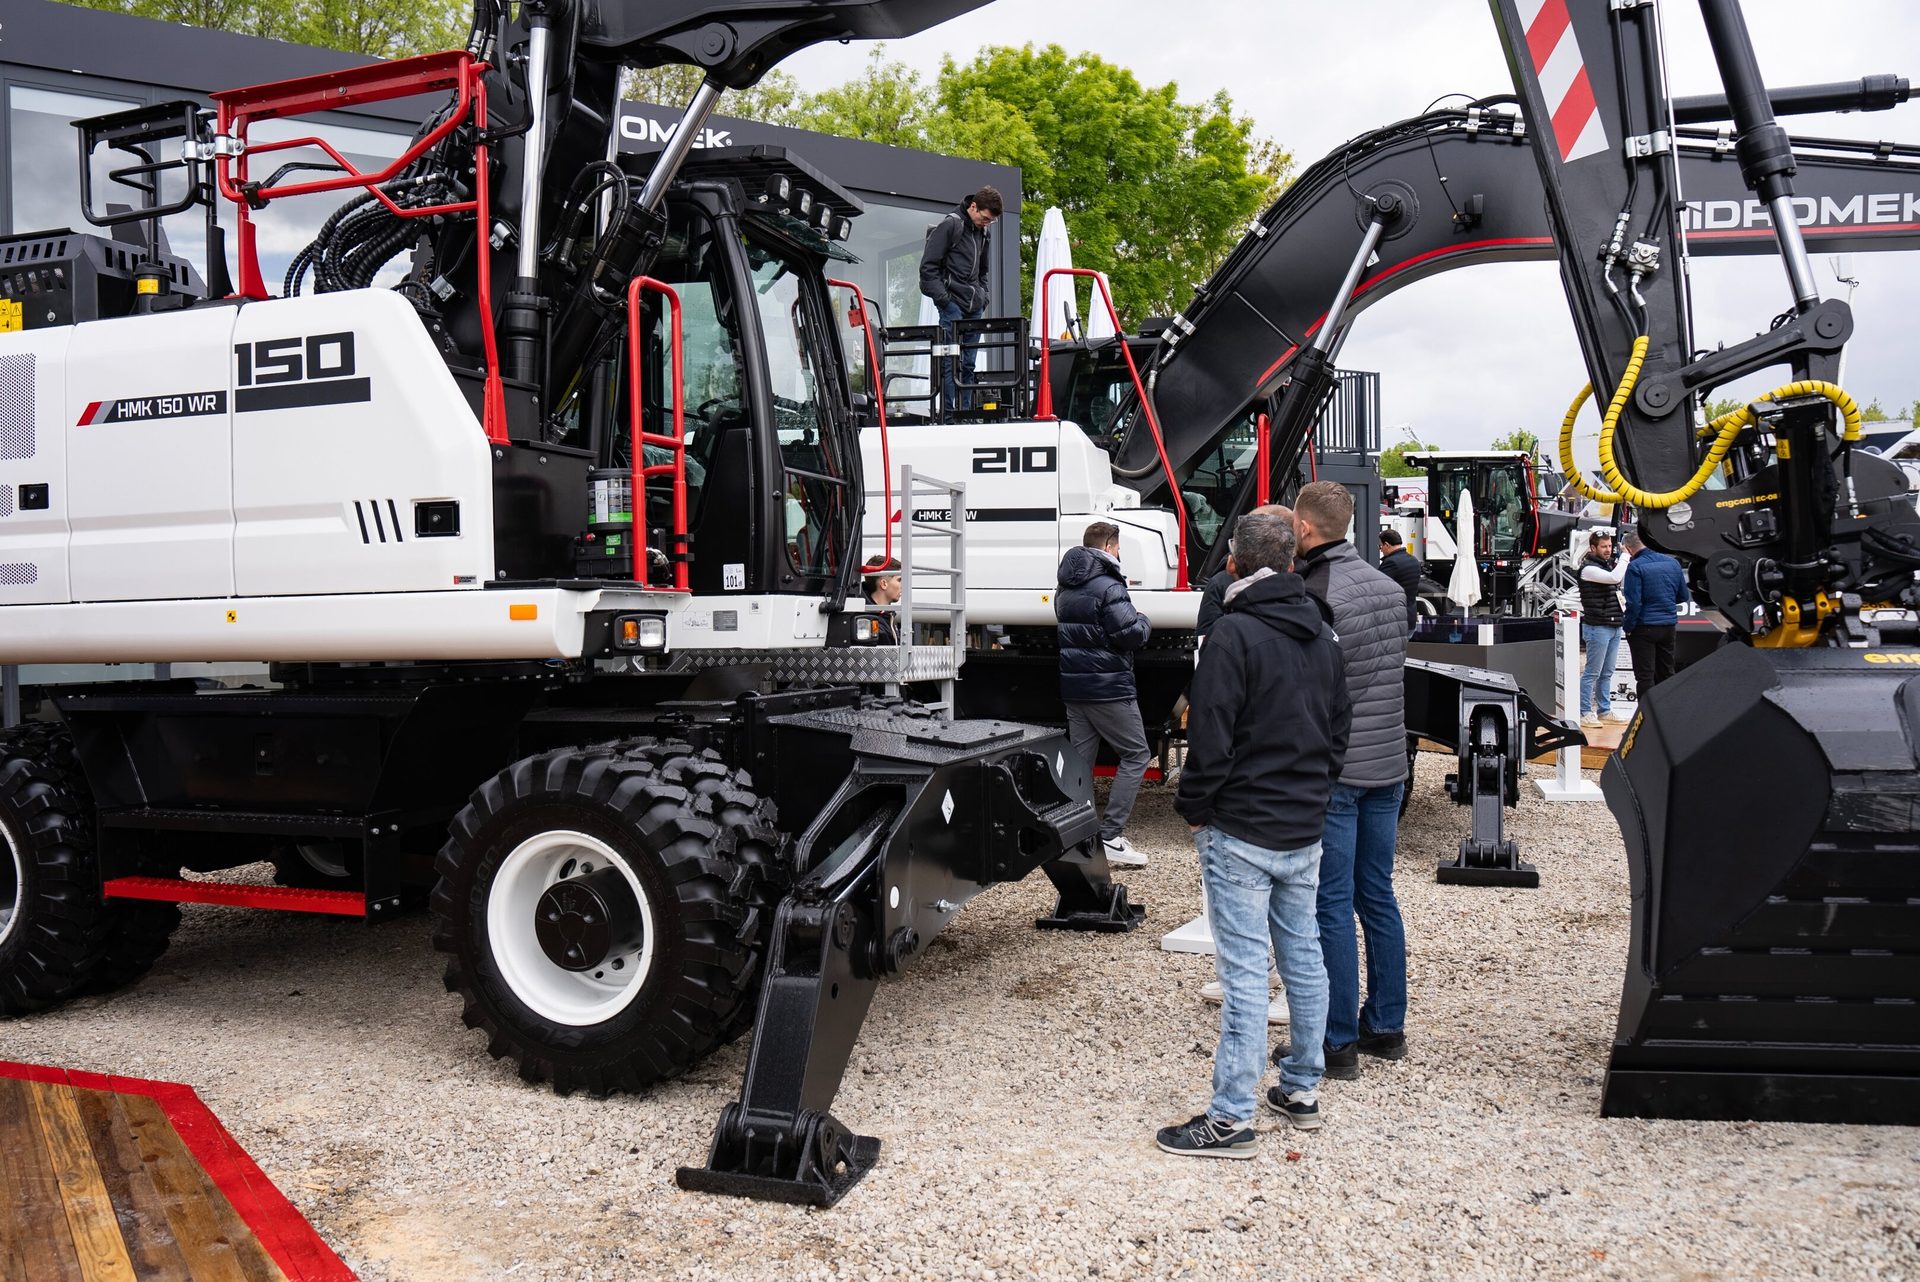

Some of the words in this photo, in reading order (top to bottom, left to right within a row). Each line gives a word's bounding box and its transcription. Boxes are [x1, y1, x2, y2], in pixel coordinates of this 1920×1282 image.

[234, 331, 356, 387] 150
[117, 400, 153, 419] HMK
[156, 397, 183, 416] 150
[187, 394, 217, 413] WR
[973, 446, 1057, 474] 210
[1715, 497, 1752, 508] engcon
[918, 511, 942, 521] HMK
[725, 575, 738, 588] 101
[1189, 1126, 1215, 1147] N
